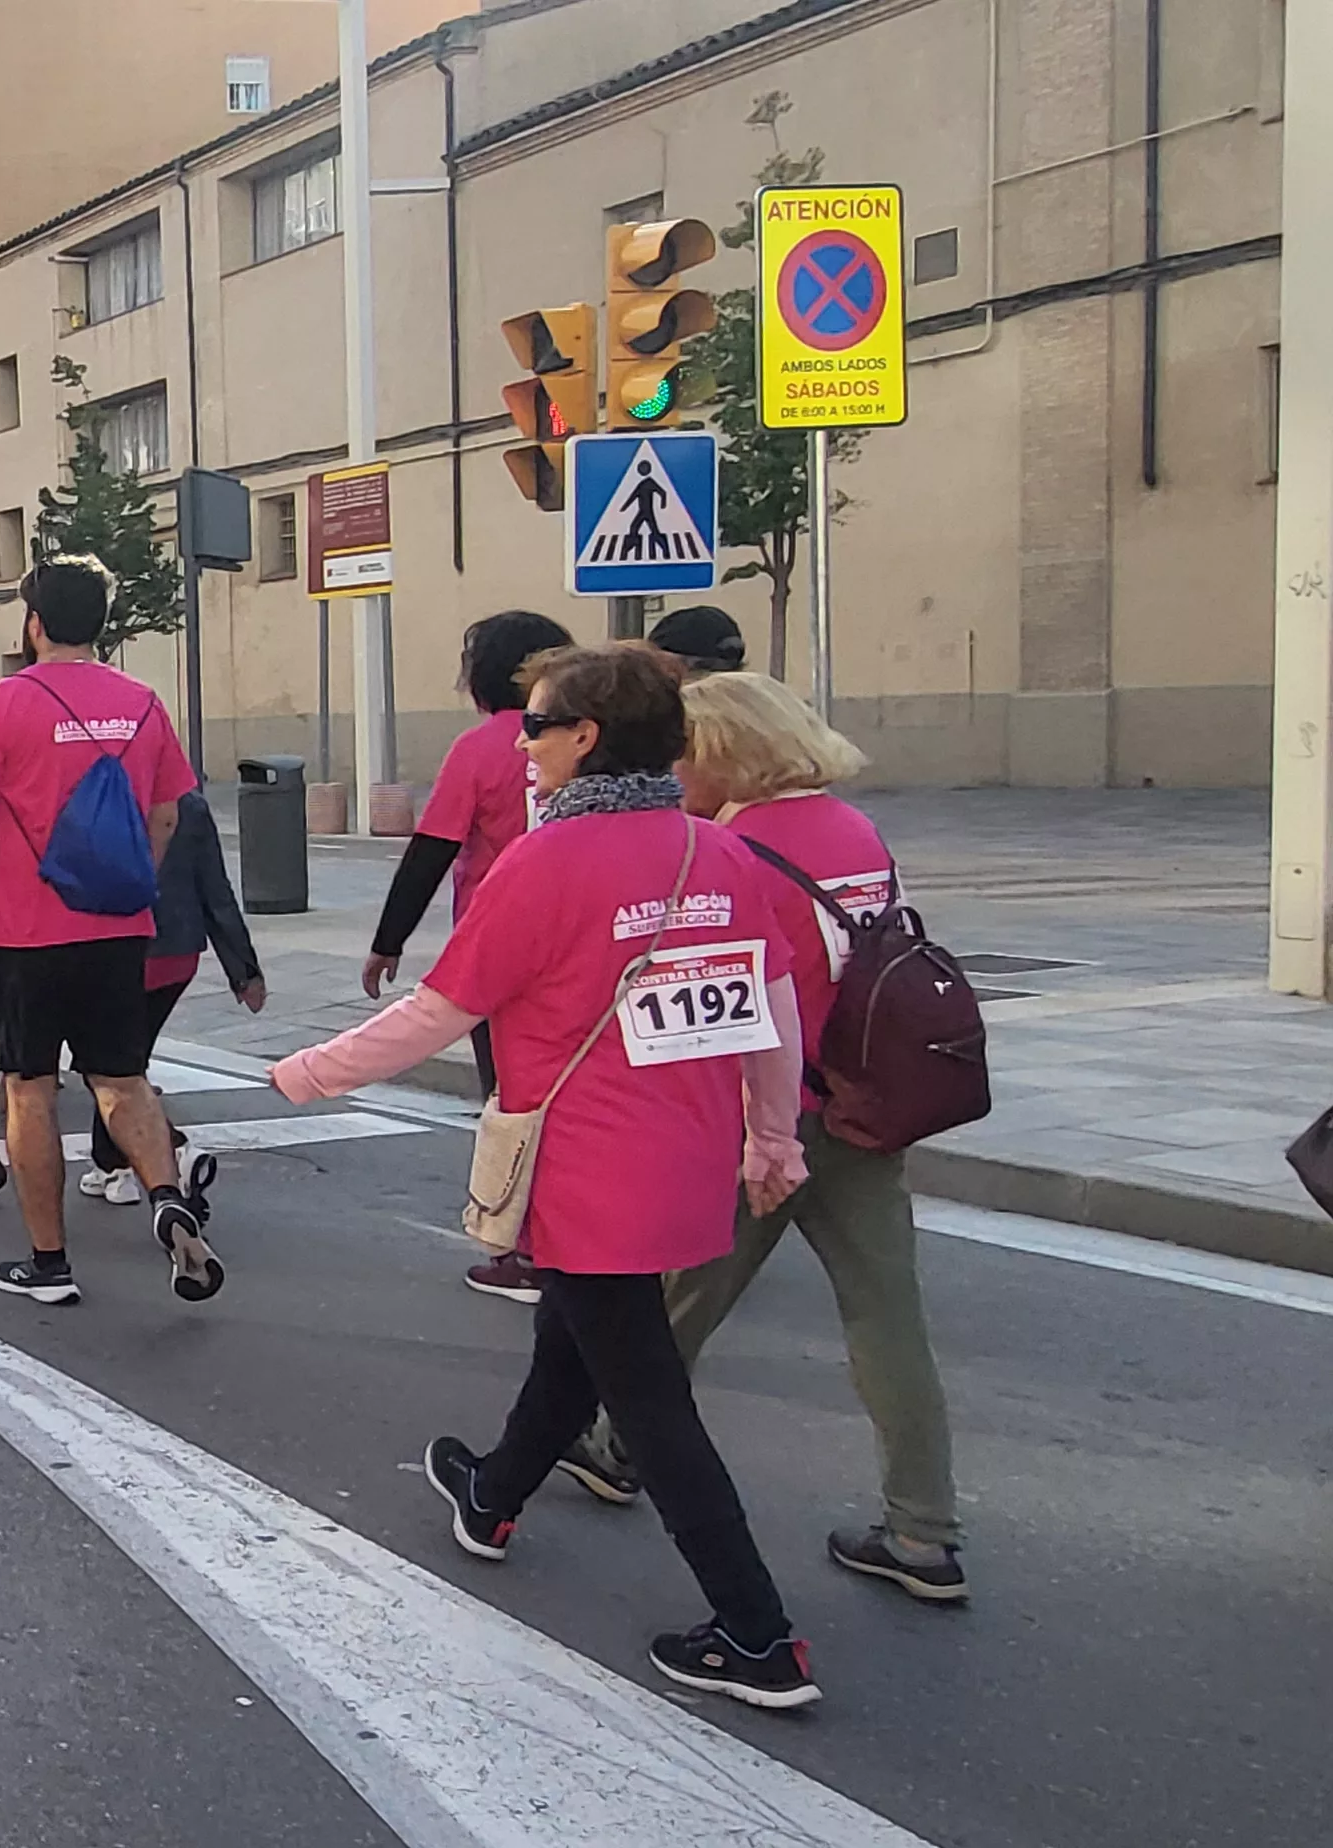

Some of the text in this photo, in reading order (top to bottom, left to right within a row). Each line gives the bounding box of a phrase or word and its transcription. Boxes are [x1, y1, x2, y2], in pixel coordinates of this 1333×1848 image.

[767, 194, 890, 221] ATENCIÓN
[781, 358, 887, 373] AMBOS LADOS
[786, 379, 880, 399] SÁBADOS
[781, 407, 799, 418] DE
[829, 406, 838, 416] A
[876, 404, 885, 414] H
[636, 981, 754, 1031] 1192
